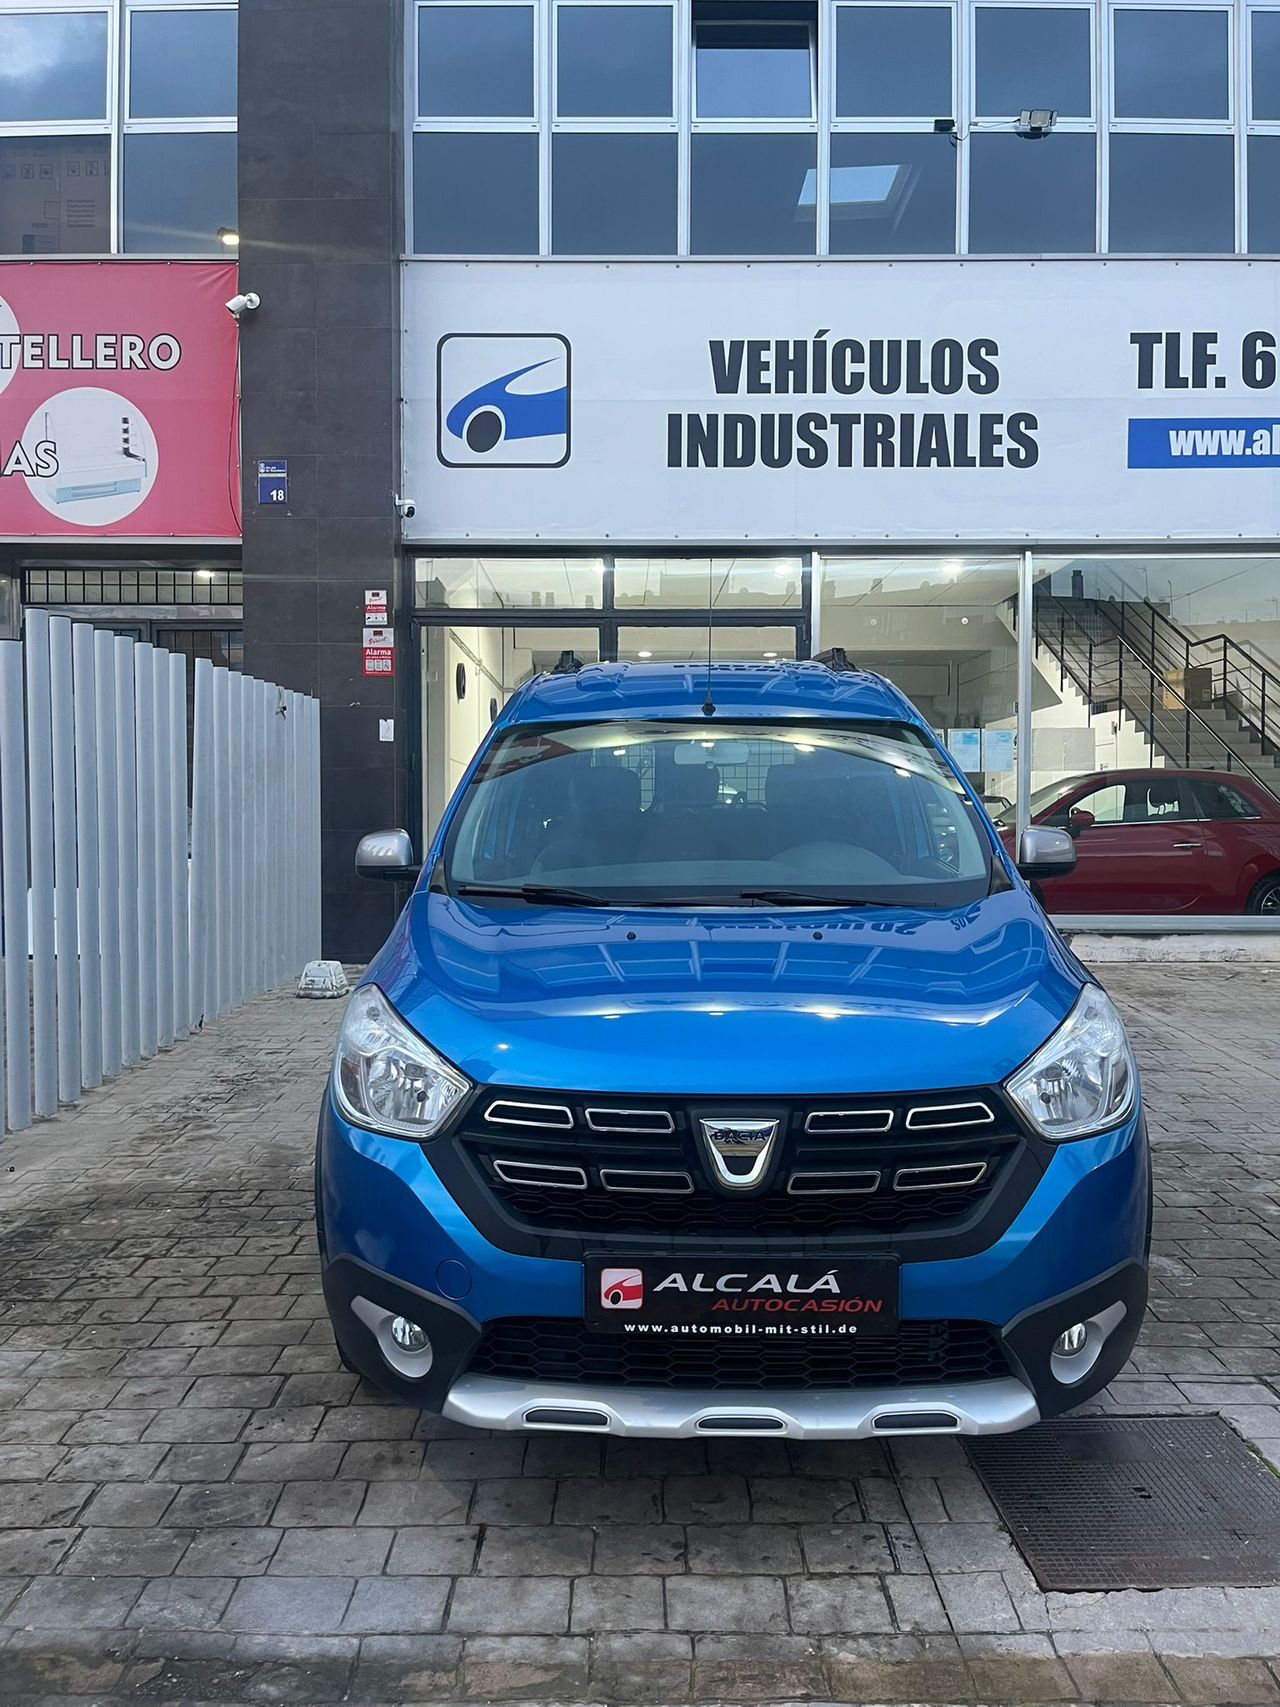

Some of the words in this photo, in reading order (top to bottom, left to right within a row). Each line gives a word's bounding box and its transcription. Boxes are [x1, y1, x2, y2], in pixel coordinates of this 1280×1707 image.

[0, 333, 182, 371] TELLERO
[708, 328, 1000, 395] VEHÍCULOS
[1130, 332, 1226, 389] TLF.
[1241, 331, 1277, 389] 6
[667, 412, 1039, 469] INDUSTRIALES
[0, 440, 59, 478] AS
[270, 489, 284, 501] 18
[714, 1131, 766, 1141] DACIA
[653, 1270, 841, 1293] ALCALÁ
[711, 1297, 883, 1312] AUTOCASIÓN
[624, 1323, 858, 1335] www.automobil-mit-stil.de
